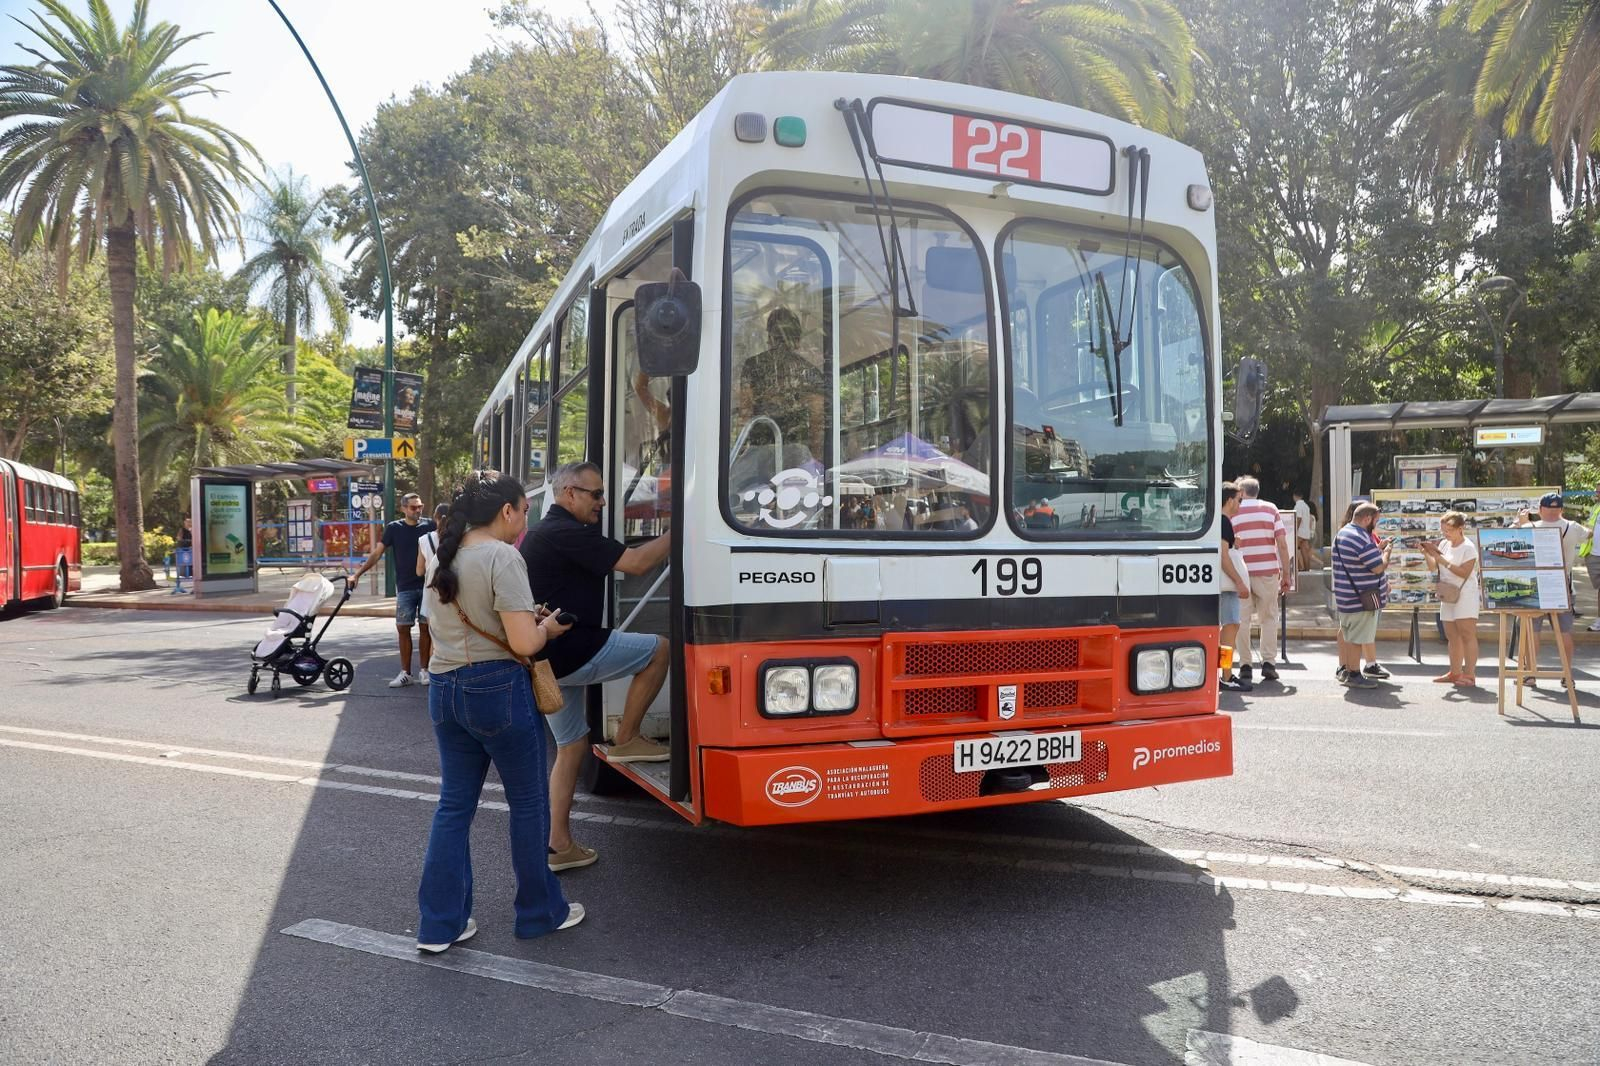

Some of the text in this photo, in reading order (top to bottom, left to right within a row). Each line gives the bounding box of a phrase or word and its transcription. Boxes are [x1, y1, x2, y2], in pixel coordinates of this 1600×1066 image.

[967, 119, 1030, 178] 22
[622, 211, 646, 246] ENTRADA
[354, 439, 368, 460] P
[738, 570, 816, 585] PEGASO
[971, 556, 1044, 598] 199
[1161, 563, 1214, 585] 6038
[960, 735, 1074, 767] H 9422 BBH
[1153, 740, 1221, 764] promedios
[860, 788, 889, 797] AUTOBUSES
